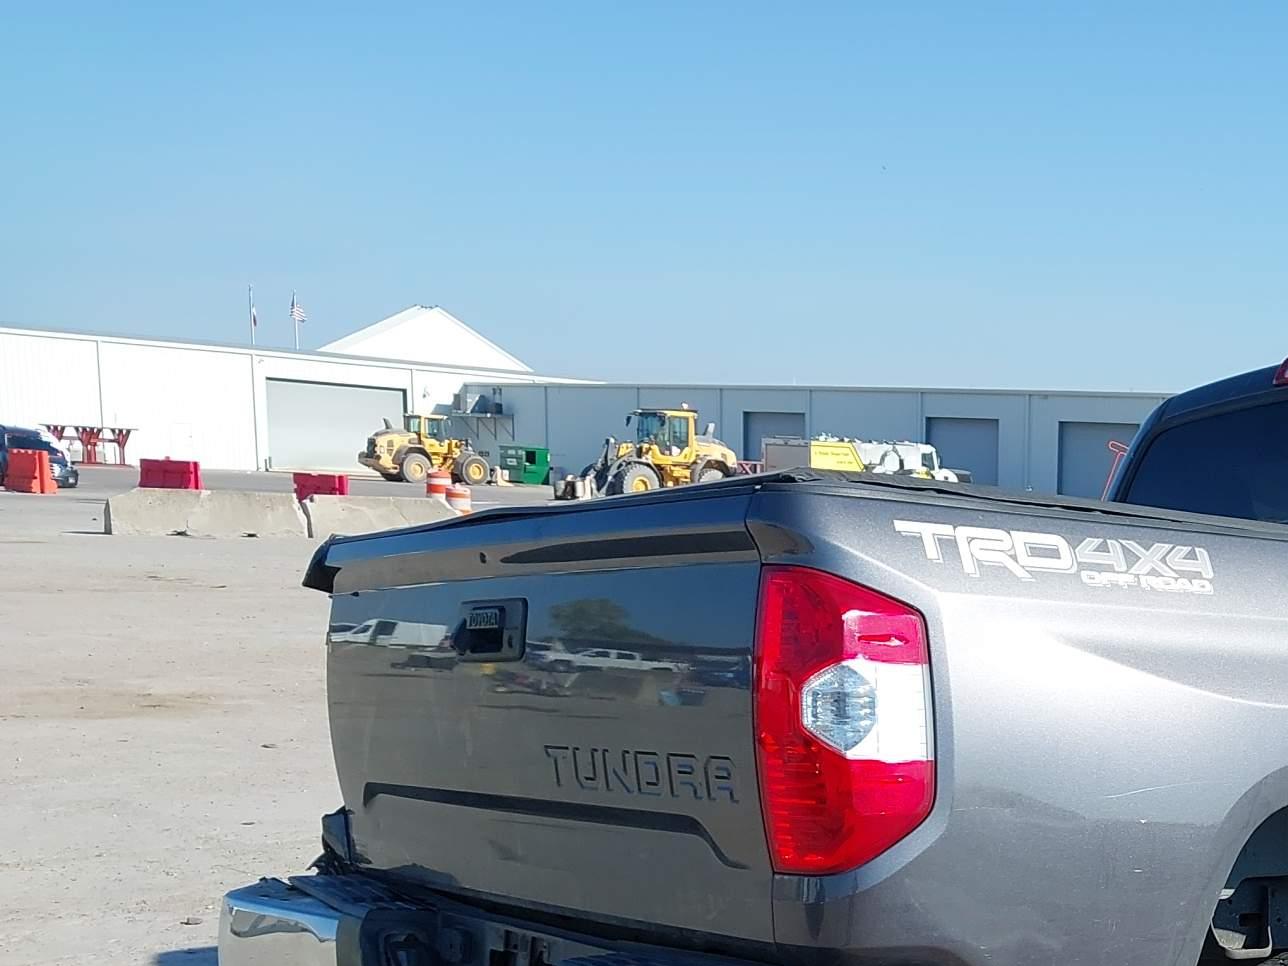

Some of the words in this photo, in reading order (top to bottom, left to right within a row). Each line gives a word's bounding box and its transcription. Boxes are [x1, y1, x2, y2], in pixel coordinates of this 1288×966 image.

[893, 519, 1077, 582] TRD
[1080, 570, 1138, 589] OFF
[1138, 574, 1214, 595] ROAD
[544, 745, 739, 803] TUNDRA
